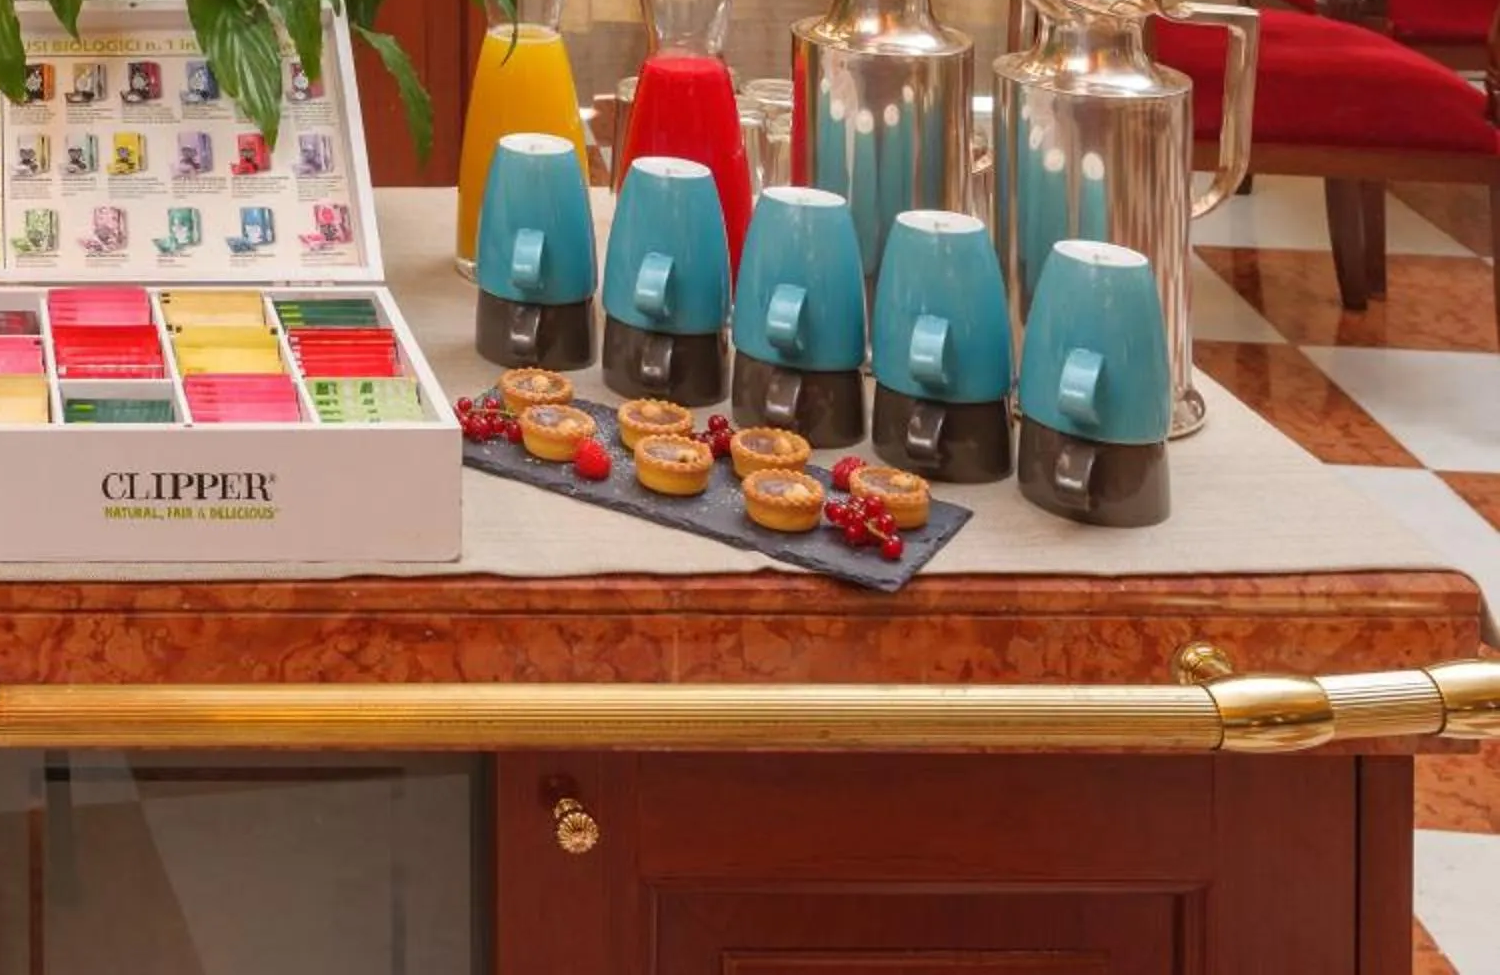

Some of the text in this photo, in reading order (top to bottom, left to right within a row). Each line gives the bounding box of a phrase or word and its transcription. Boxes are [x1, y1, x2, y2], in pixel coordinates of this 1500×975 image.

[51, 38, 139, 52] BIOLOGICI
[101, 472, 272, 502] CLIPPER
[208, 506, 276, 519] DELICIOUS
